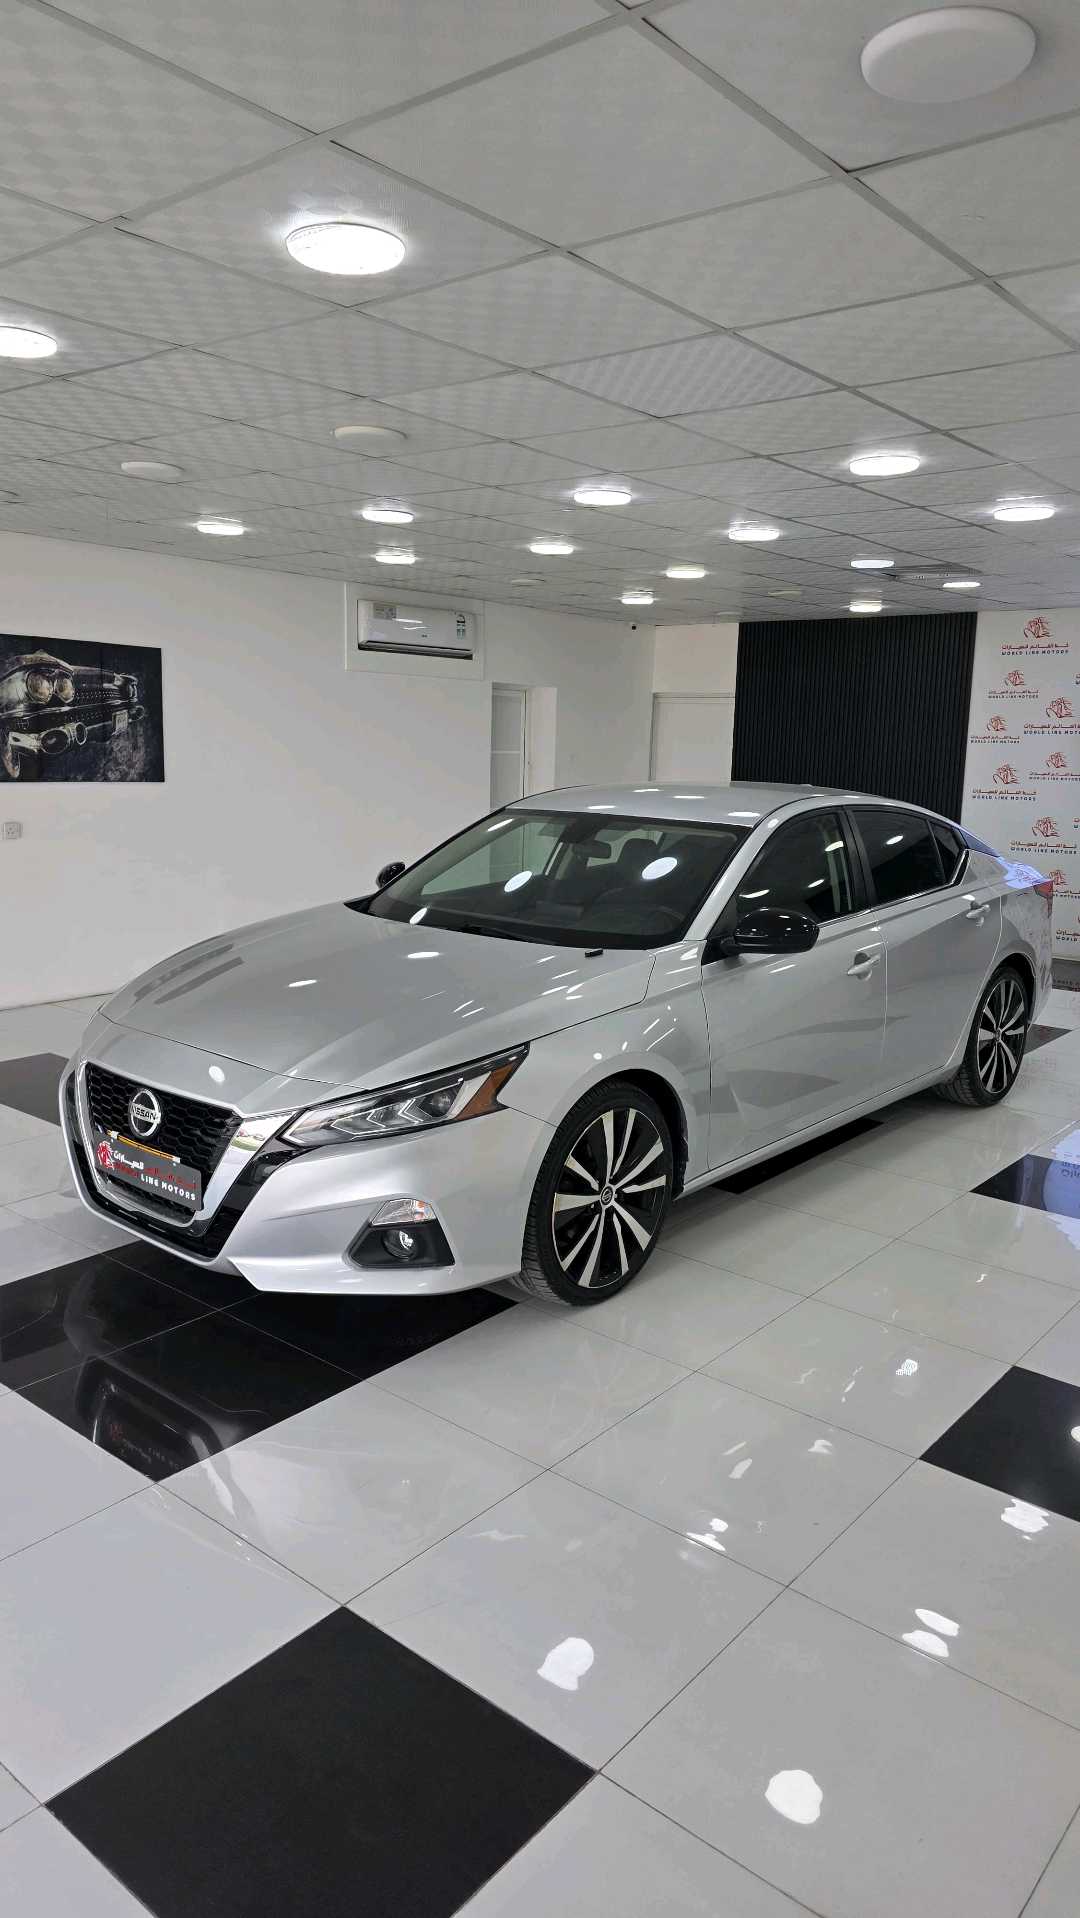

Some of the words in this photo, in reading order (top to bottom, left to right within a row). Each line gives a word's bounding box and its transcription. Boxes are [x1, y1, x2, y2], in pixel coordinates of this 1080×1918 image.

[132, 1104, 157, 1121] NISSAN
[140, 1173, 160, 1188] LINE
[161, 1180, 197, 1201] MOTORS
